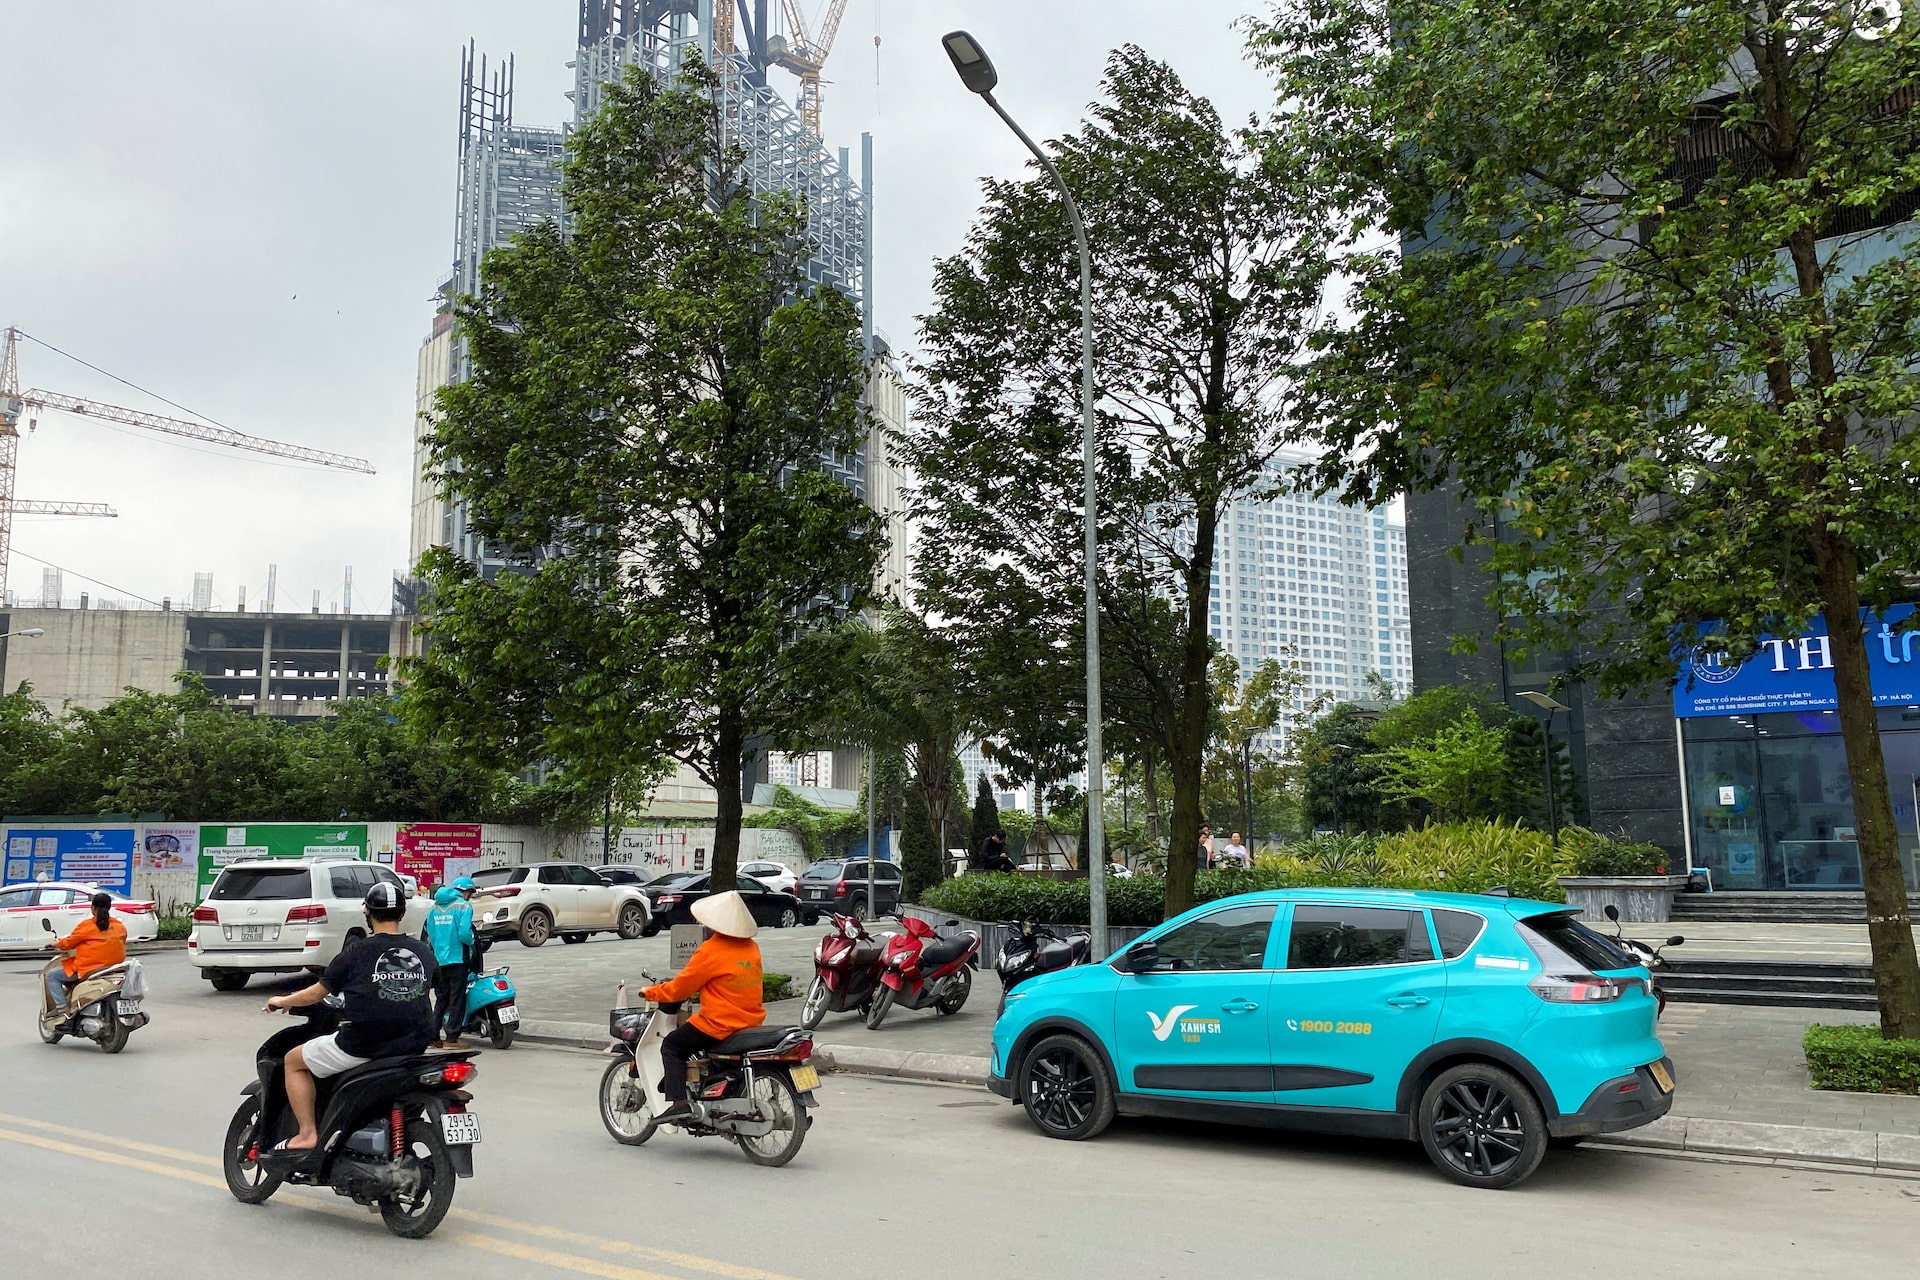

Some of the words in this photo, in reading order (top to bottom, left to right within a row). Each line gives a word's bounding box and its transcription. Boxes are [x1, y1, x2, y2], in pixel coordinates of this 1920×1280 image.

[1762, 635, 1835, 672] TH
[1180, 1022, 1206, 1033] XANH
[1207, 1023, 1221, 1034] SM
[1299, 1020, 1333, 1033] 1900
[1335, 1021, 1372, 1035] 2088
[447, 1114, 474, 1128] 29-L5
[447, 1128, 479, 1142] 537.30
